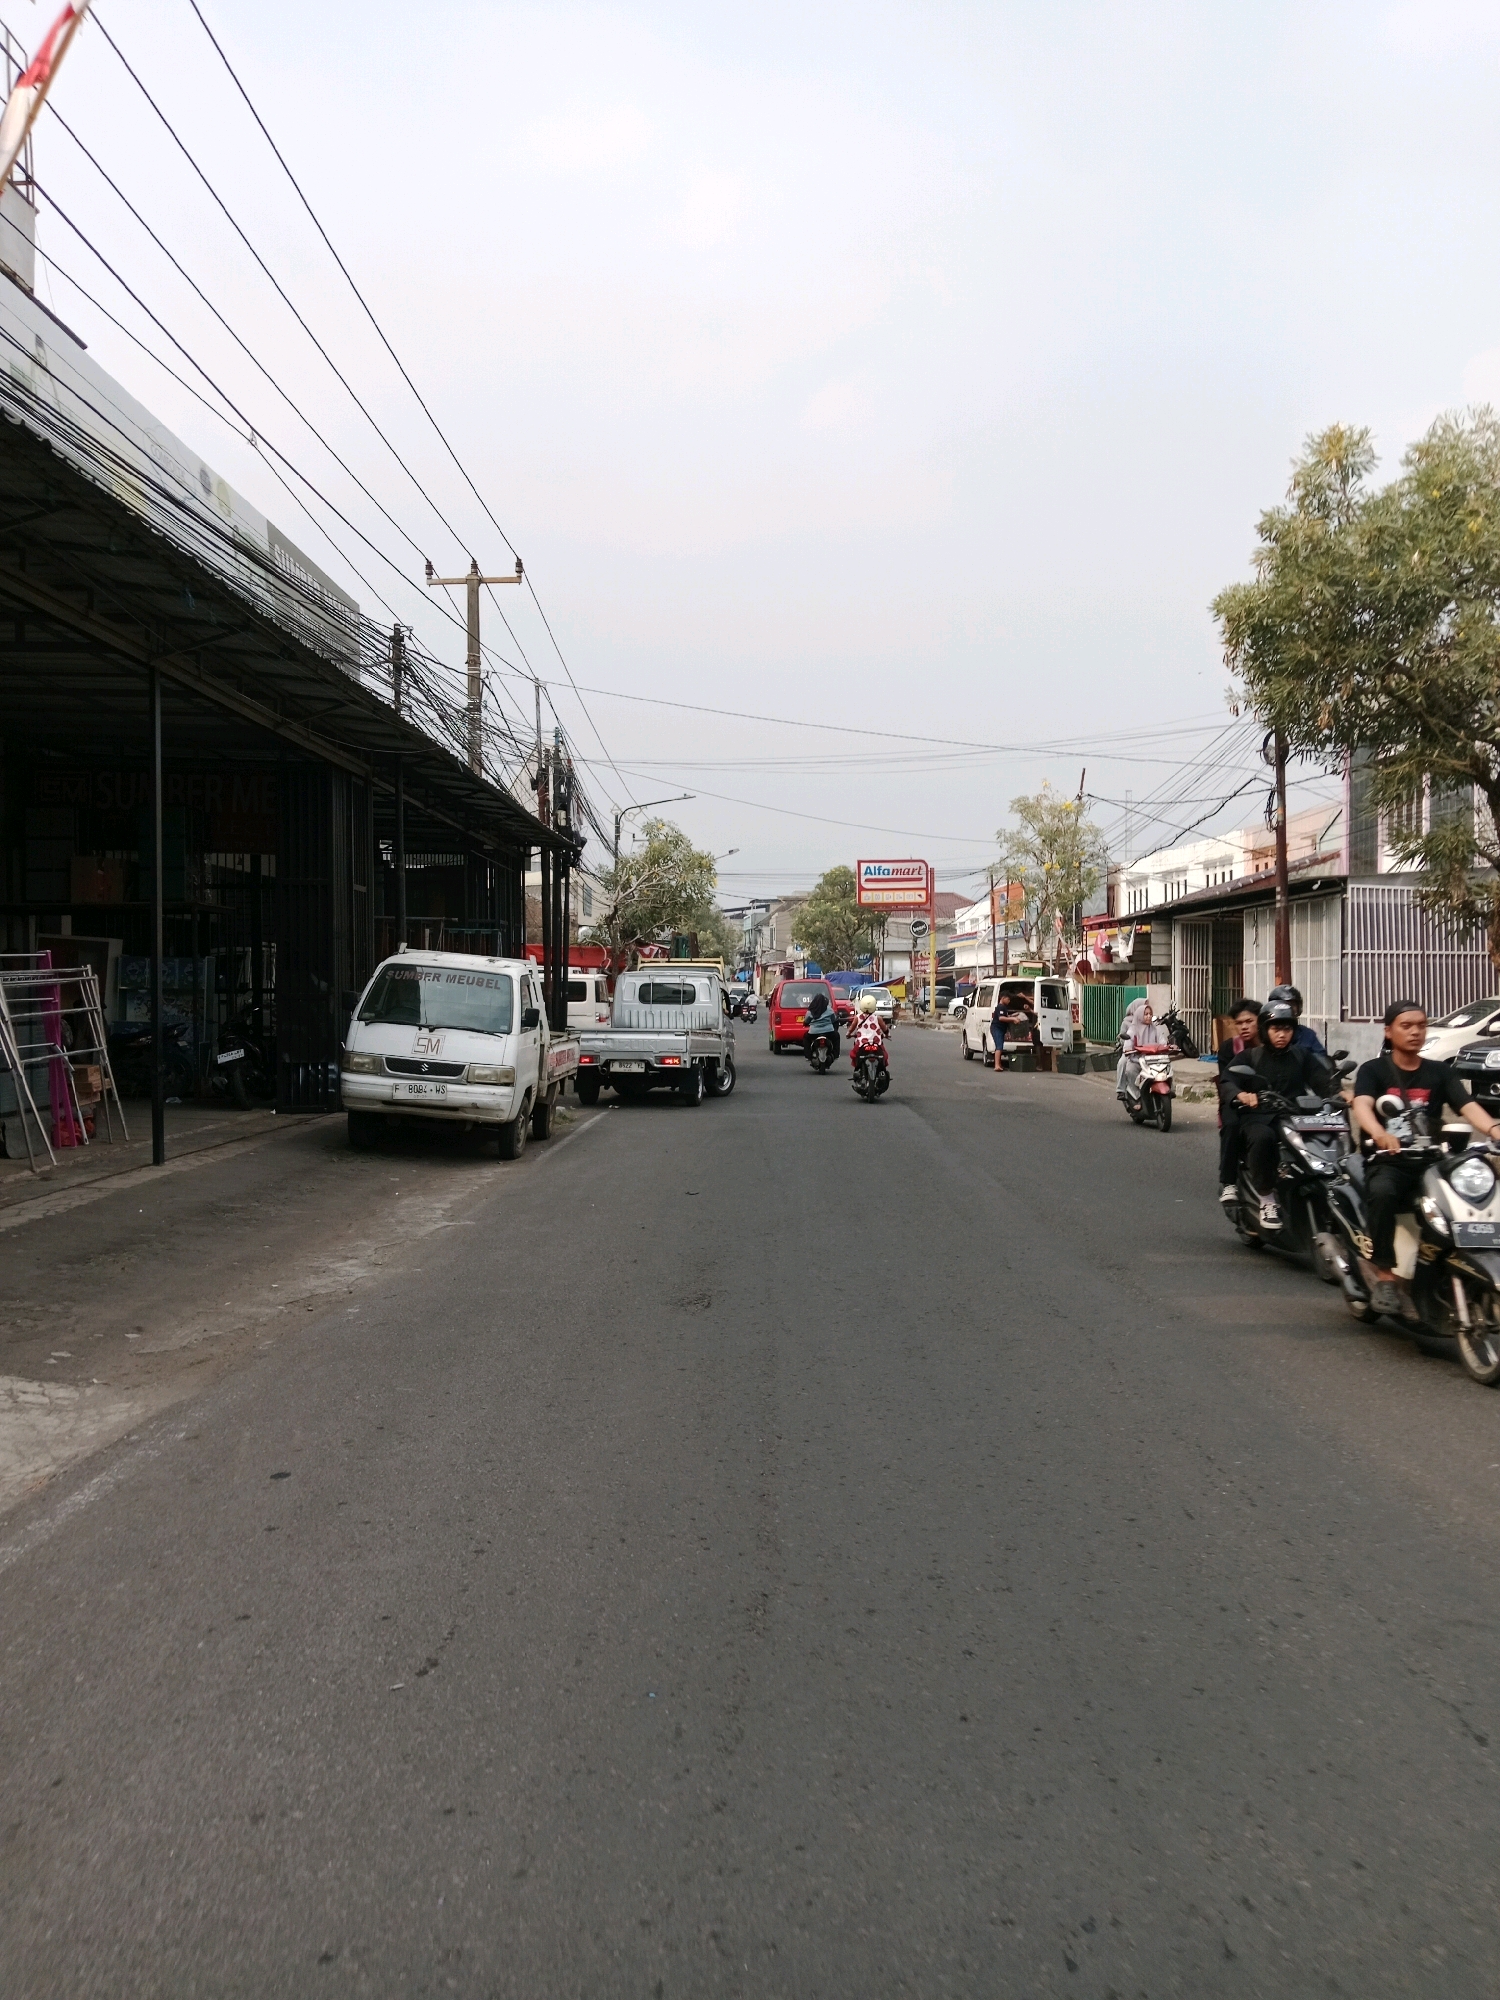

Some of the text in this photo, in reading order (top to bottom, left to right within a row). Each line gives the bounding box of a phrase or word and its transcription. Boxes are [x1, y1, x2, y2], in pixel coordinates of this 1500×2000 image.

[864, 865, 924, 876] Alfamart
[385, 970, 501, 990] SUMBER MEUBEL
[414, 1037, 441, 1055] SM
[394, 1084, 400, 1093] F
